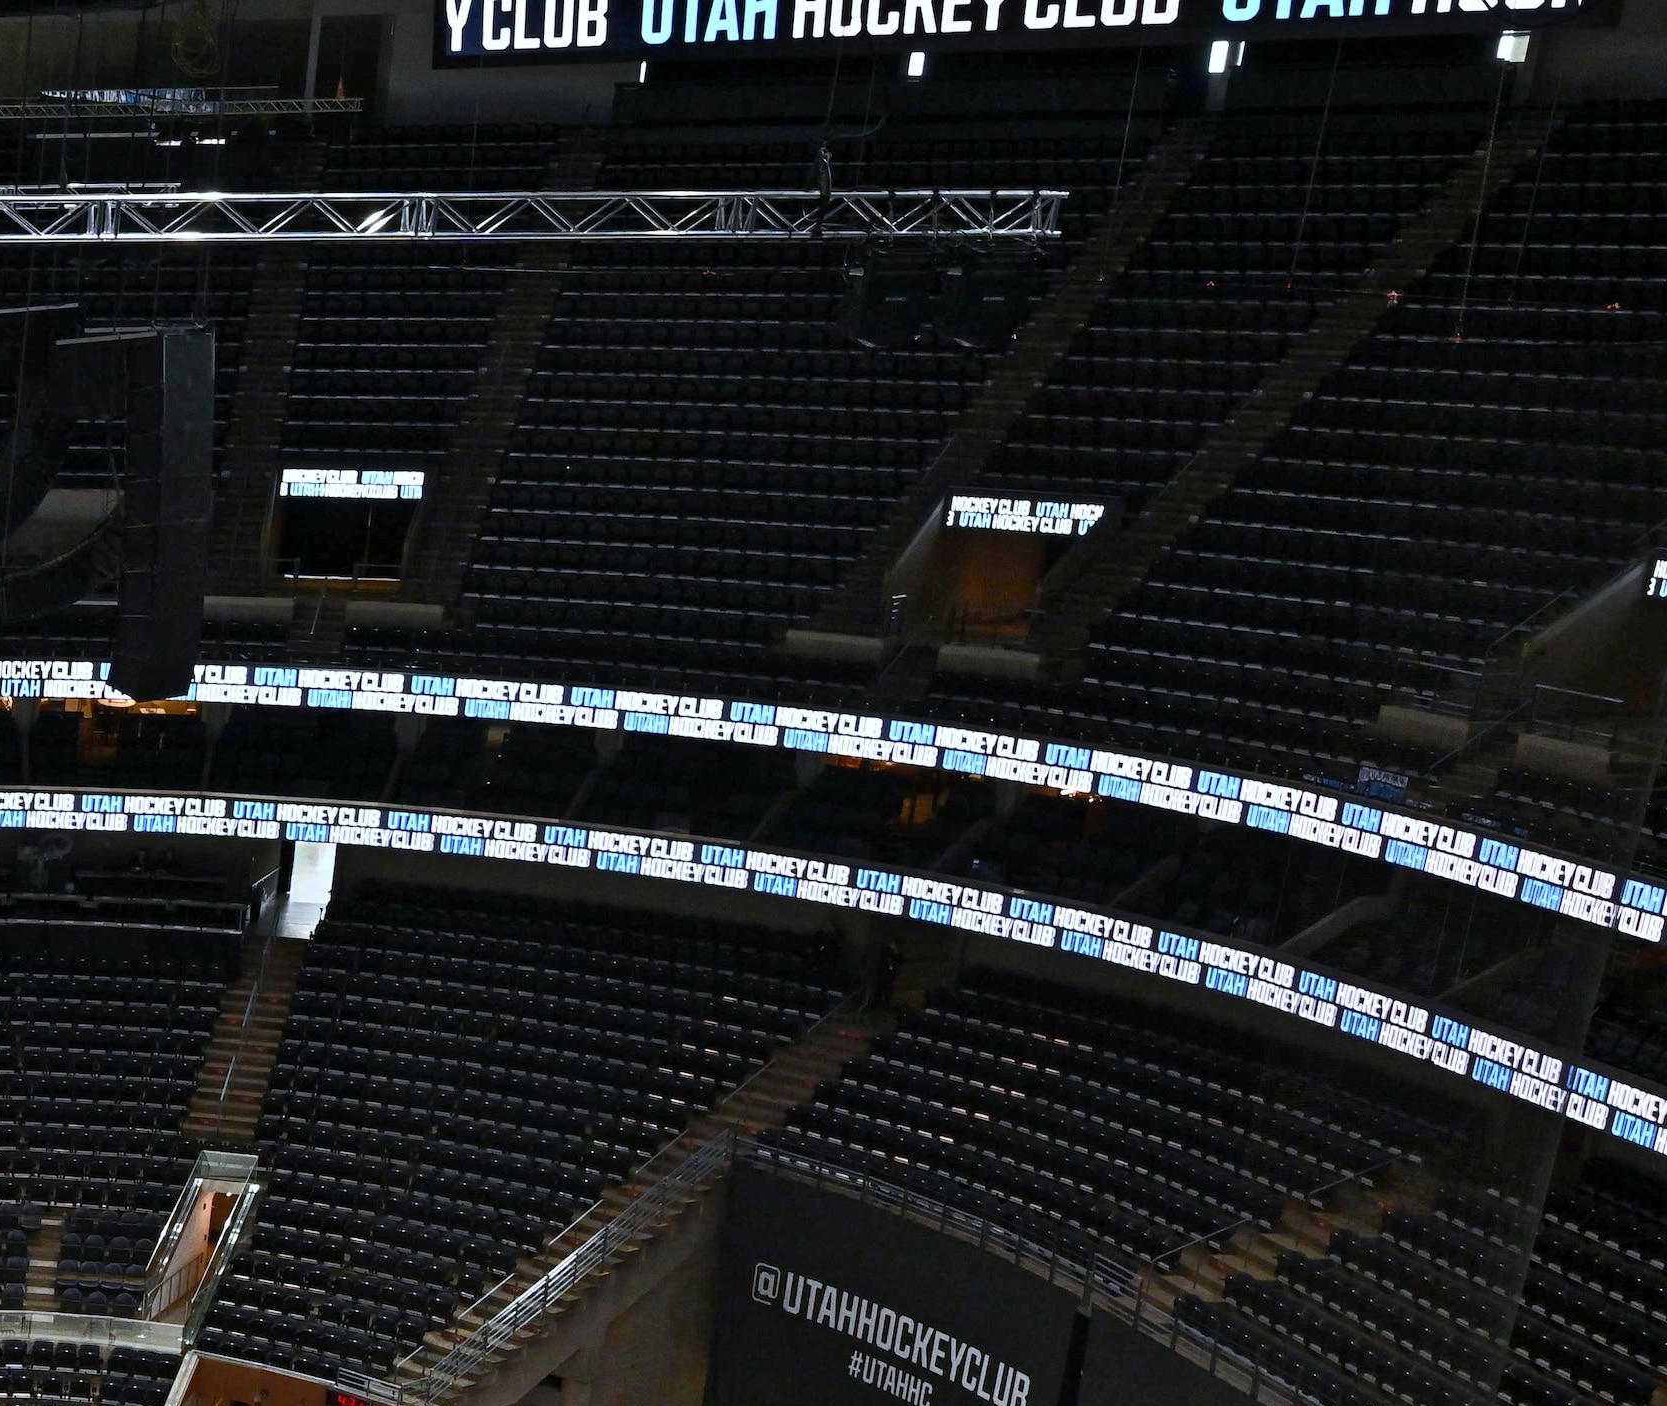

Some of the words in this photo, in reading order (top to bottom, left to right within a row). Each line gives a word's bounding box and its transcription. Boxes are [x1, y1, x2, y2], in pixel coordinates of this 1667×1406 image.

[446, 4, 470, 52] Y
[480, 2, 608, 51] CLUB
[640, 0, 776, 44] UTAH
[792, 0, 1001, 39] HOCKEY
[254, 667, 297, 687] UTAH
[297, 668, 361, 690] HOCKEY
[361, 672, 404, 693] CLUB
[34, 793, 74, 811] CLUB
[1341, 802, 1382, 832] UTAH
[1380, 811, 1439, 846] HOCKEY
[1436, 826, 1476, 857] CLUB
[1158, 931, 1200, 960] UTAH
[1198, 942, 1260, 976] HOCKEY
[1257, 957, 1295, 987] CLUB
